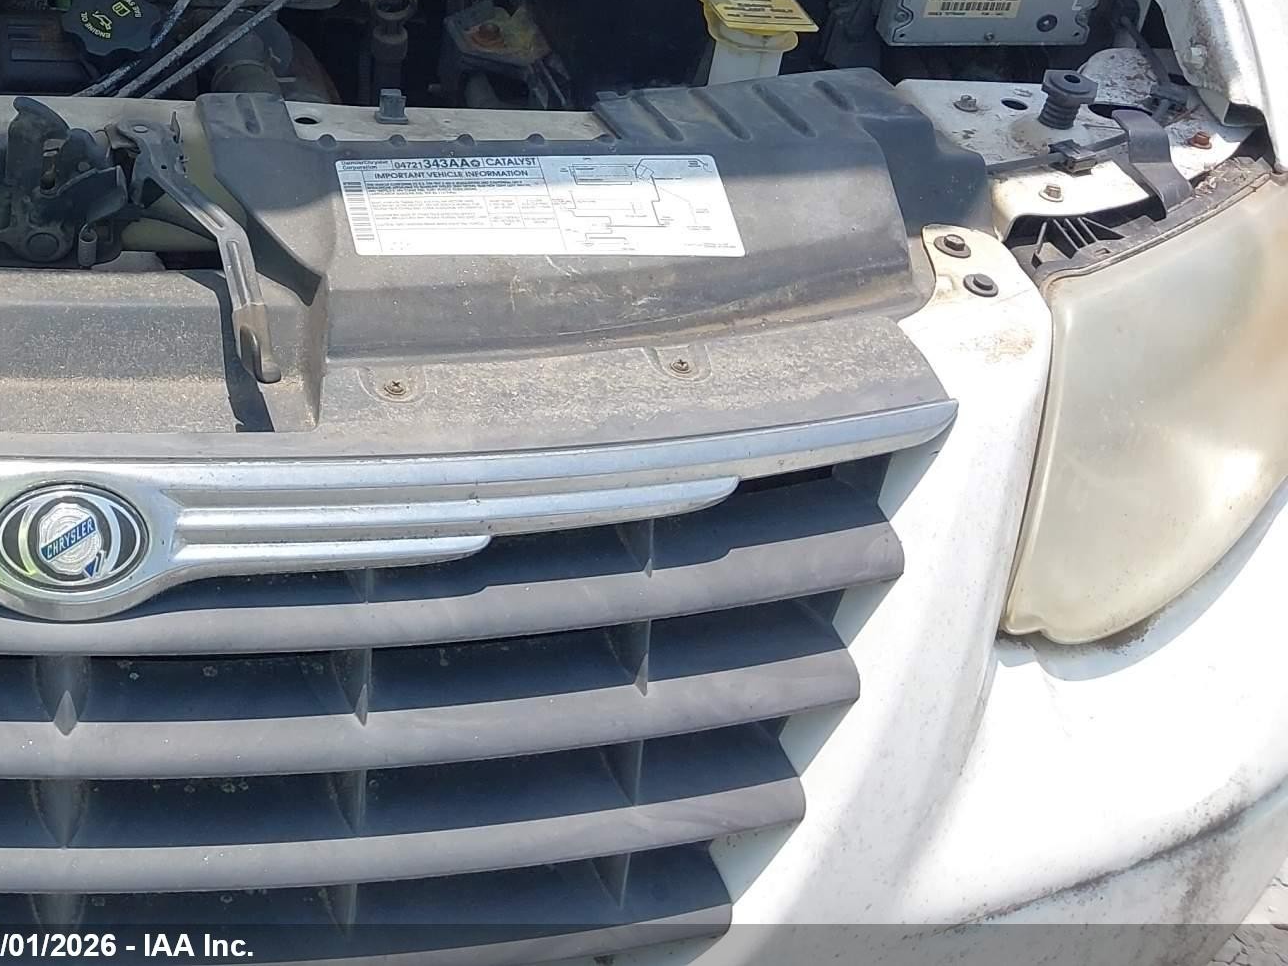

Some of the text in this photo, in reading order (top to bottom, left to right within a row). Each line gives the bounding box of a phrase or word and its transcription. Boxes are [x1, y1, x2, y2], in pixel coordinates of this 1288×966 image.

[85, 23, 111, 39] ENGINE
[485, 157, 537, 166] CATALYST
[465, 169, 529, 178] INFORMATION
[46, 519, 94, 558] CHRYSLER
